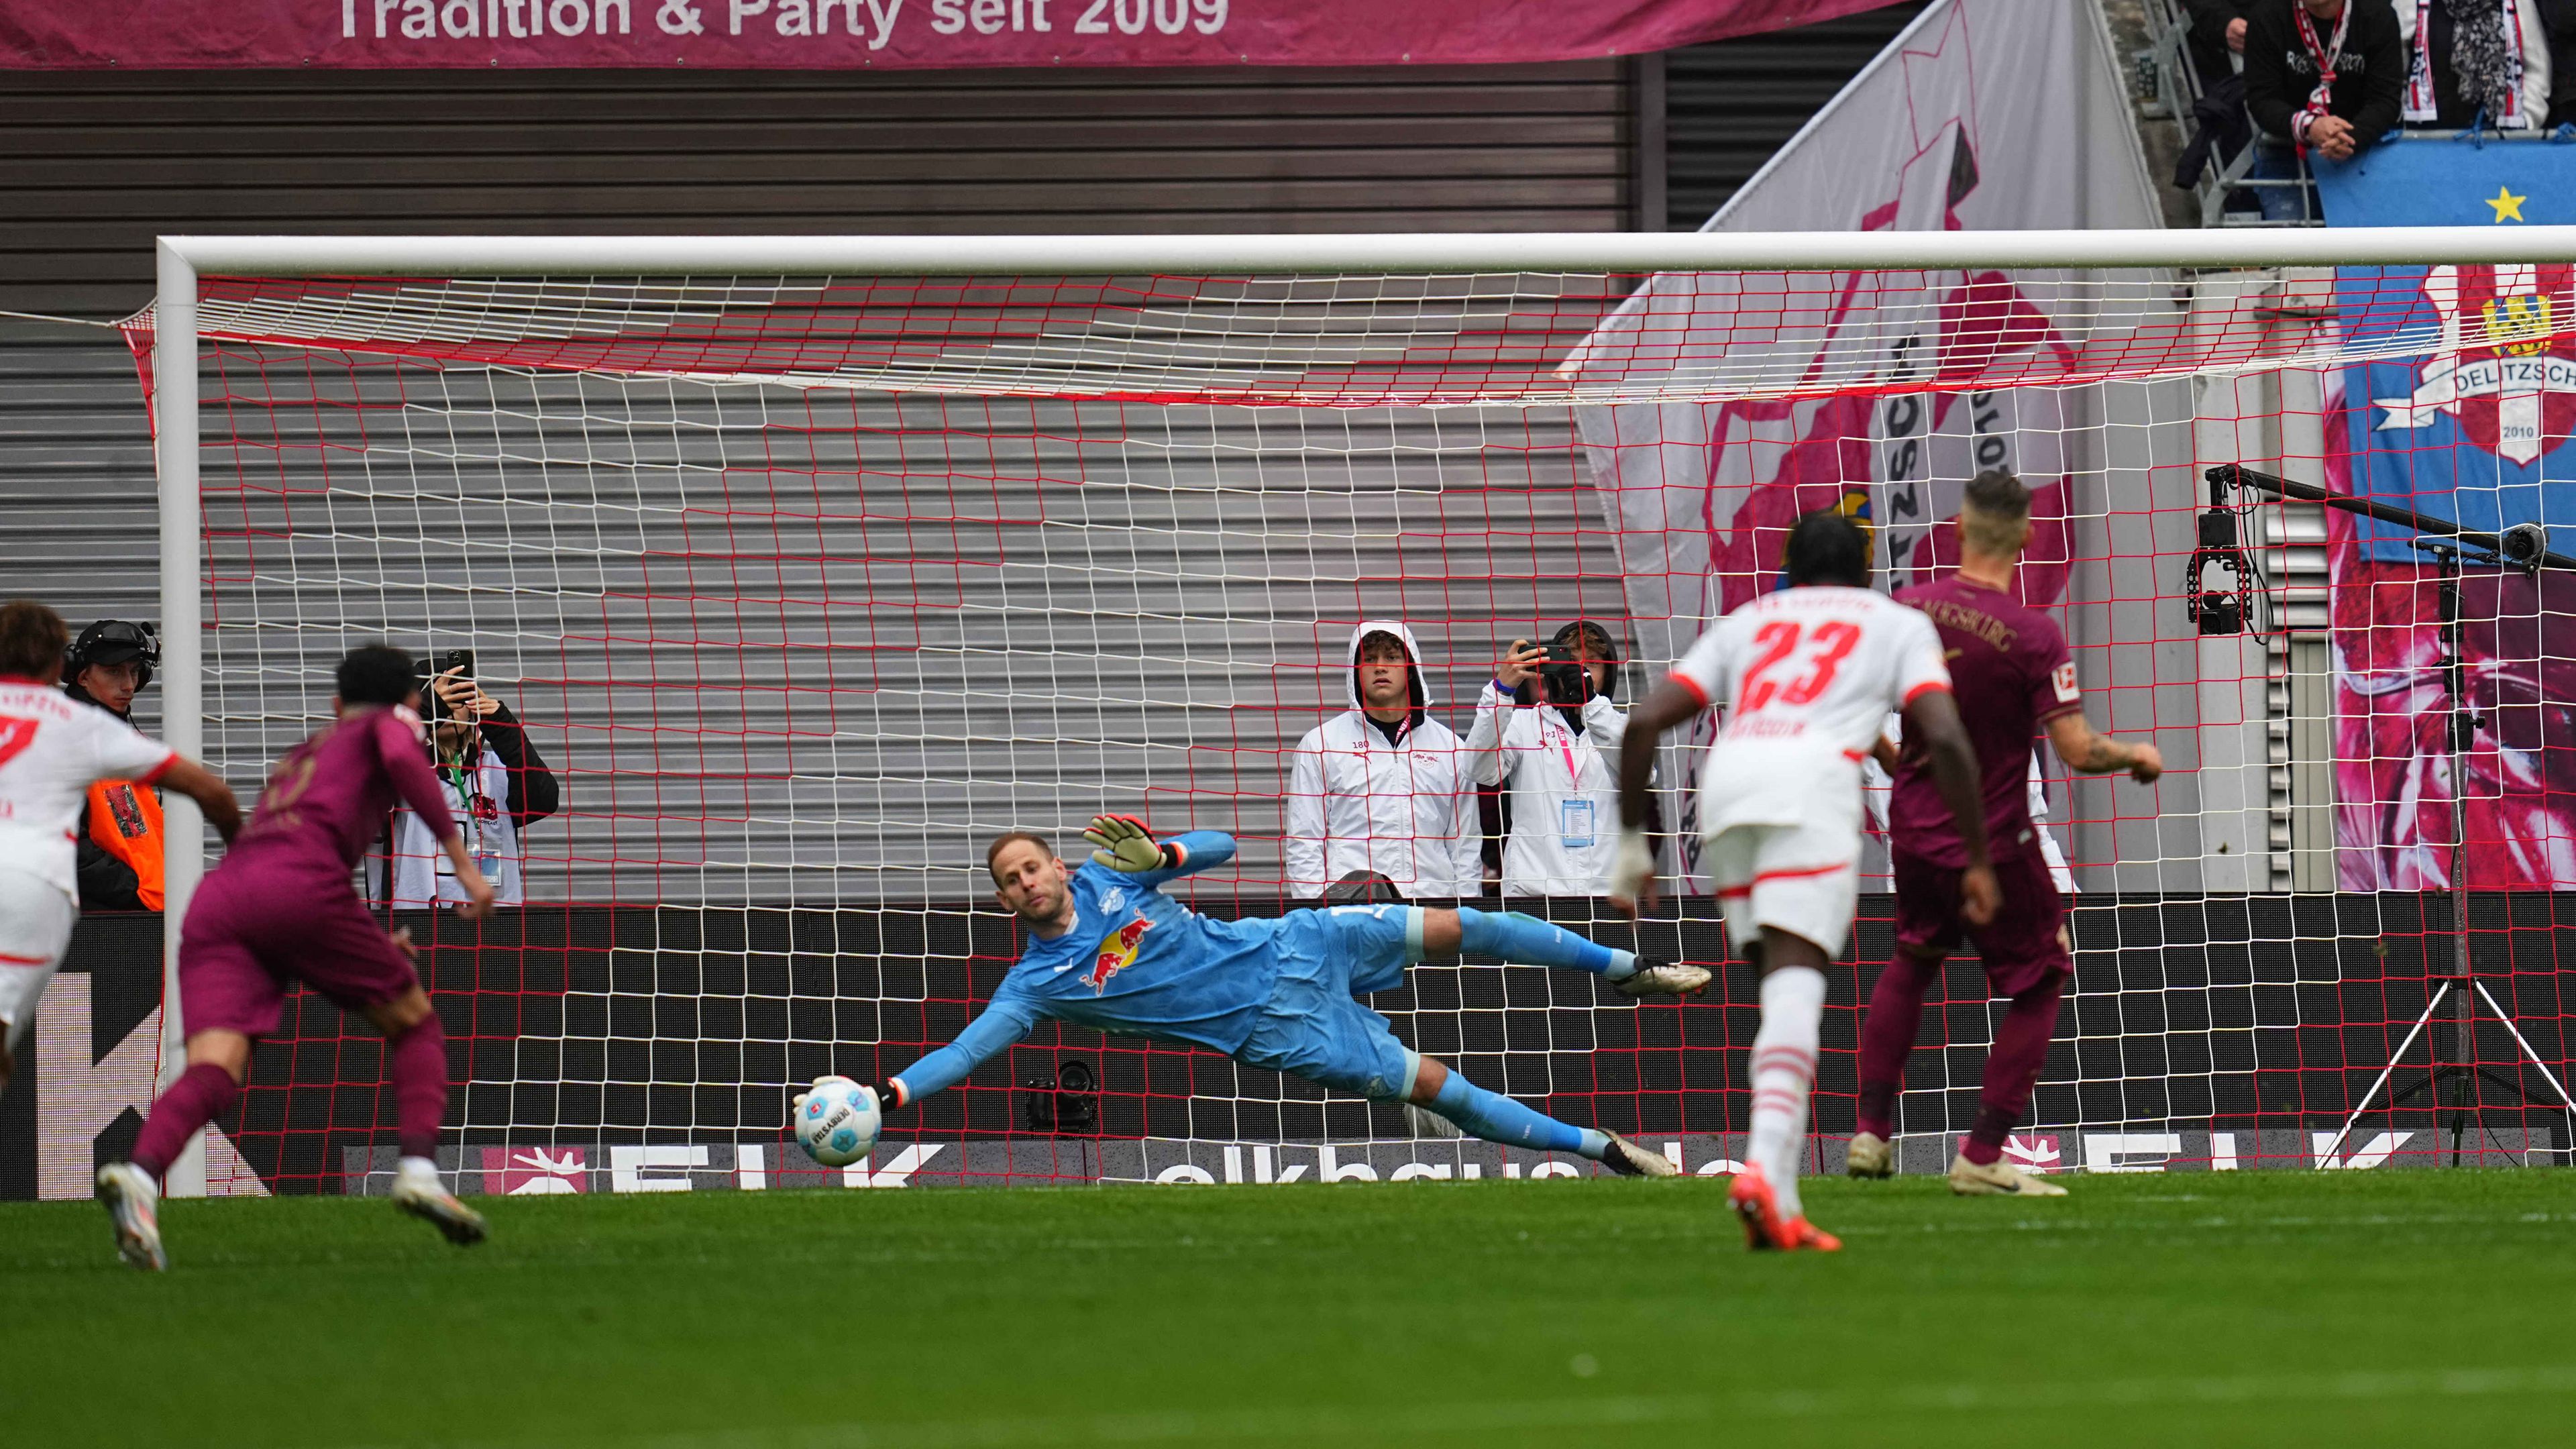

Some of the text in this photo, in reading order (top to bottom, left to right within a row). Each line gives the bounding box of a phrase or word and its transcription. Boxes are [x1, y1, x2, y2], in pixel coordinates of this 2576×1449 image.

[655, 0, 705, 36] &
[729, 0, 903, 50] Party
[930, 0, 1051, 34] seit
[1074, 0, 1229, 35] 2009
[2504, 426, 2534, 437] 2010
[1735, 620, 1861, 716] 23
[1352, 741, 1370, 749] 180
[812, 1107, 851, 1144] DERBYSTAR
